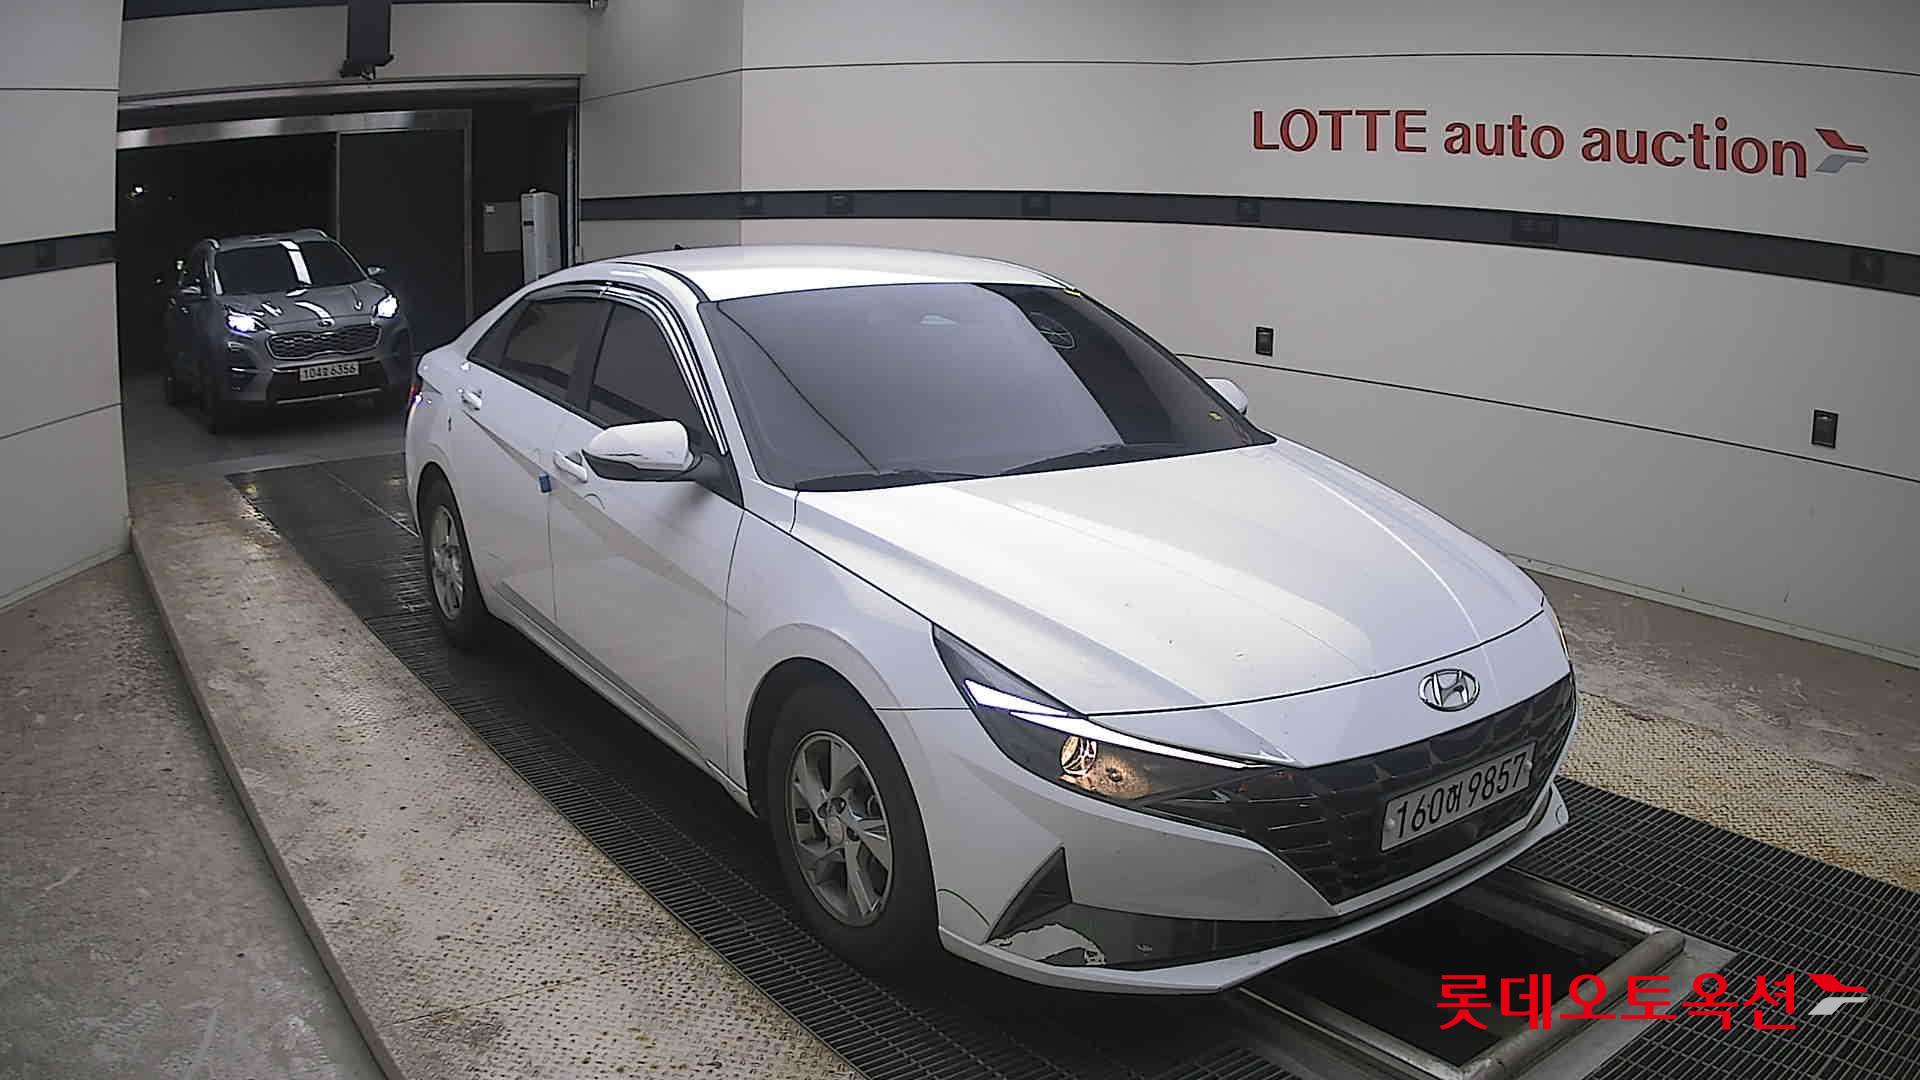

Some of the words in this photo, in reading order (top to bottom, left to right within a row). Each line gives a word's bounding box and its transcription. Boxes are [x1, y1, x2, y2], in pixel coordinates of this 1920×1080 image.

[1253, 109, 1427, 152] LOTTE
[1444, 115, 1565, 159] auto
[1581, 117, 1808, 178] auction
[1396, 780, 1464, 839] 160허
[1467, 751, 1527, 808] 9857
